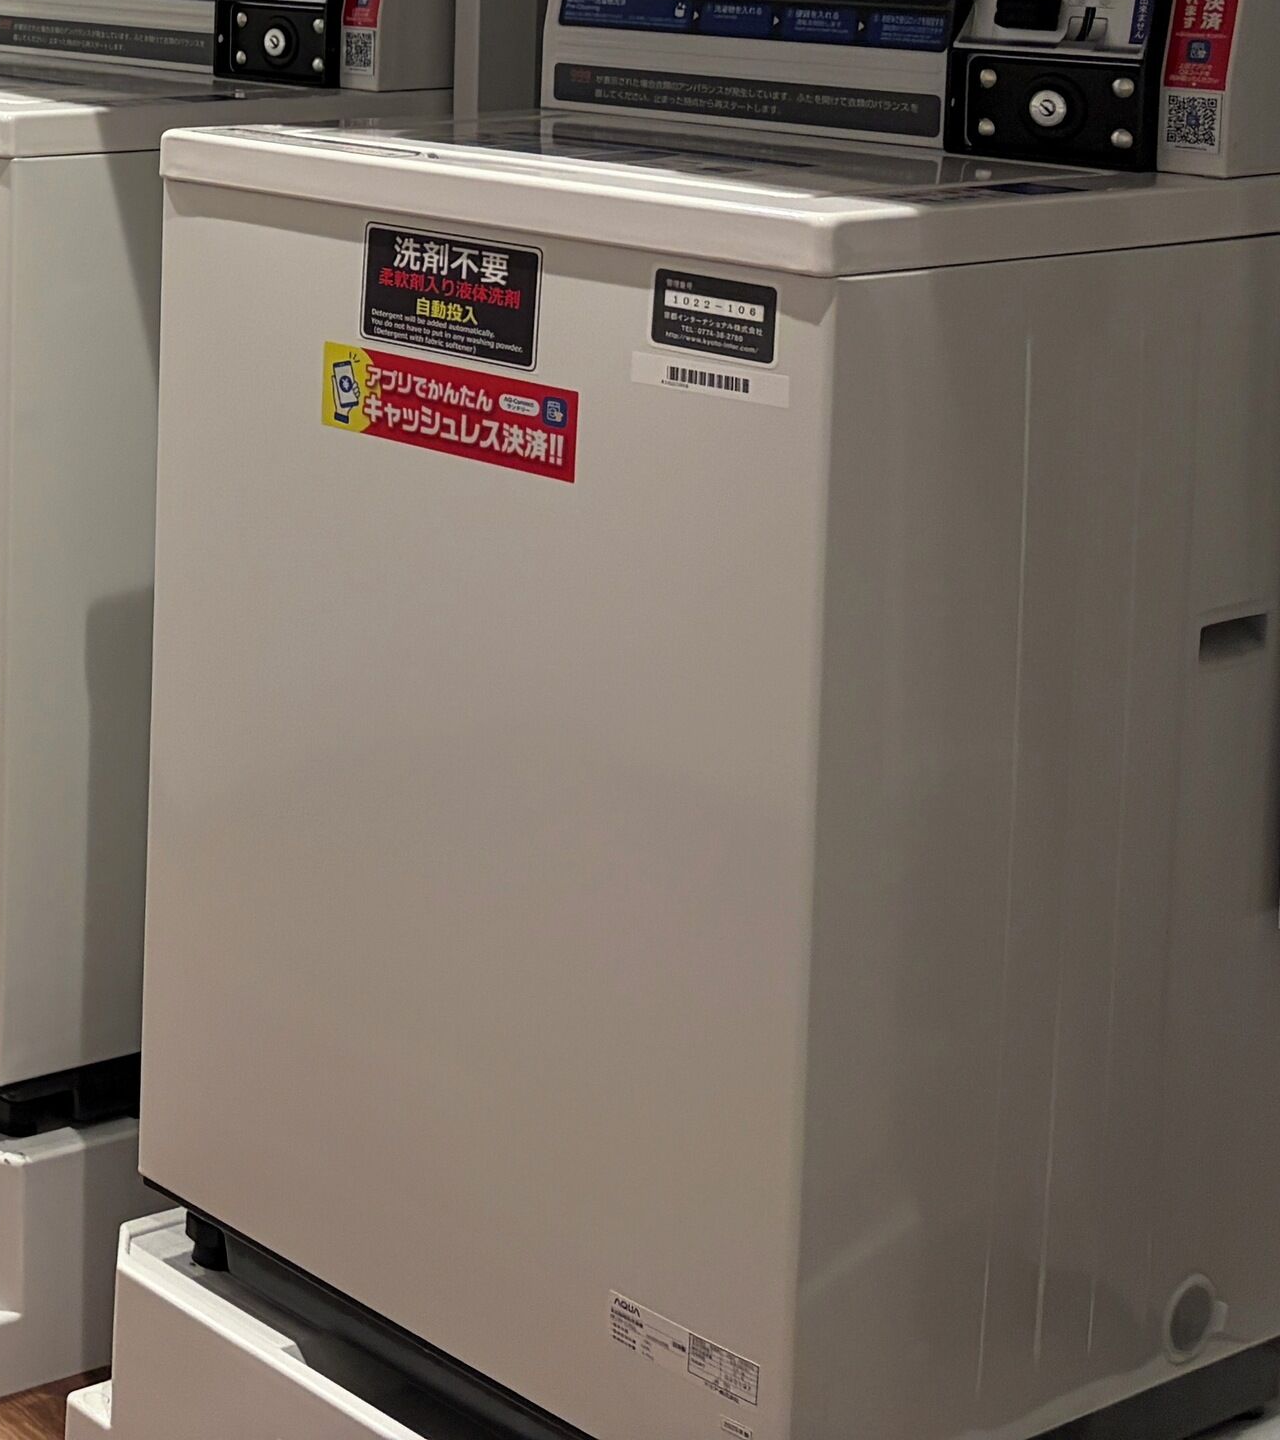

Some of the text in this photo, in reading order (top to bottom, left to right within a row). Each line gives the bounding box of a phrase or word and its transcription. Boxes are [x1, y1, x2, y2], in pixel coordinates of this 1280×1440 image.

[392, 235, 510, 286] 洗剤不要
[379, 267, 521, 311] 柔軟剤入り液体洗剤
[371, 308, 403, 322] Detergent
[405, 313, 416, 323] will
[426, 317, 447, 329] added
[449, 322, 495, 338] automatically.
[415, 297, 478, 326] 自動投入
[371, 317, 383, 327] You
[384, 320, 393, 329] do
[406, 324, 422, 333] have
[432, 328, 443, 339] put
[452, 332, 465, 342] any
[467, 334, 494, 349] washing
[495, 341, 523, 353] powder.
[374, 326, 476, 355] (Detergent with fabric softener)
[366, 365, 493, 412] アプリでかんたん
